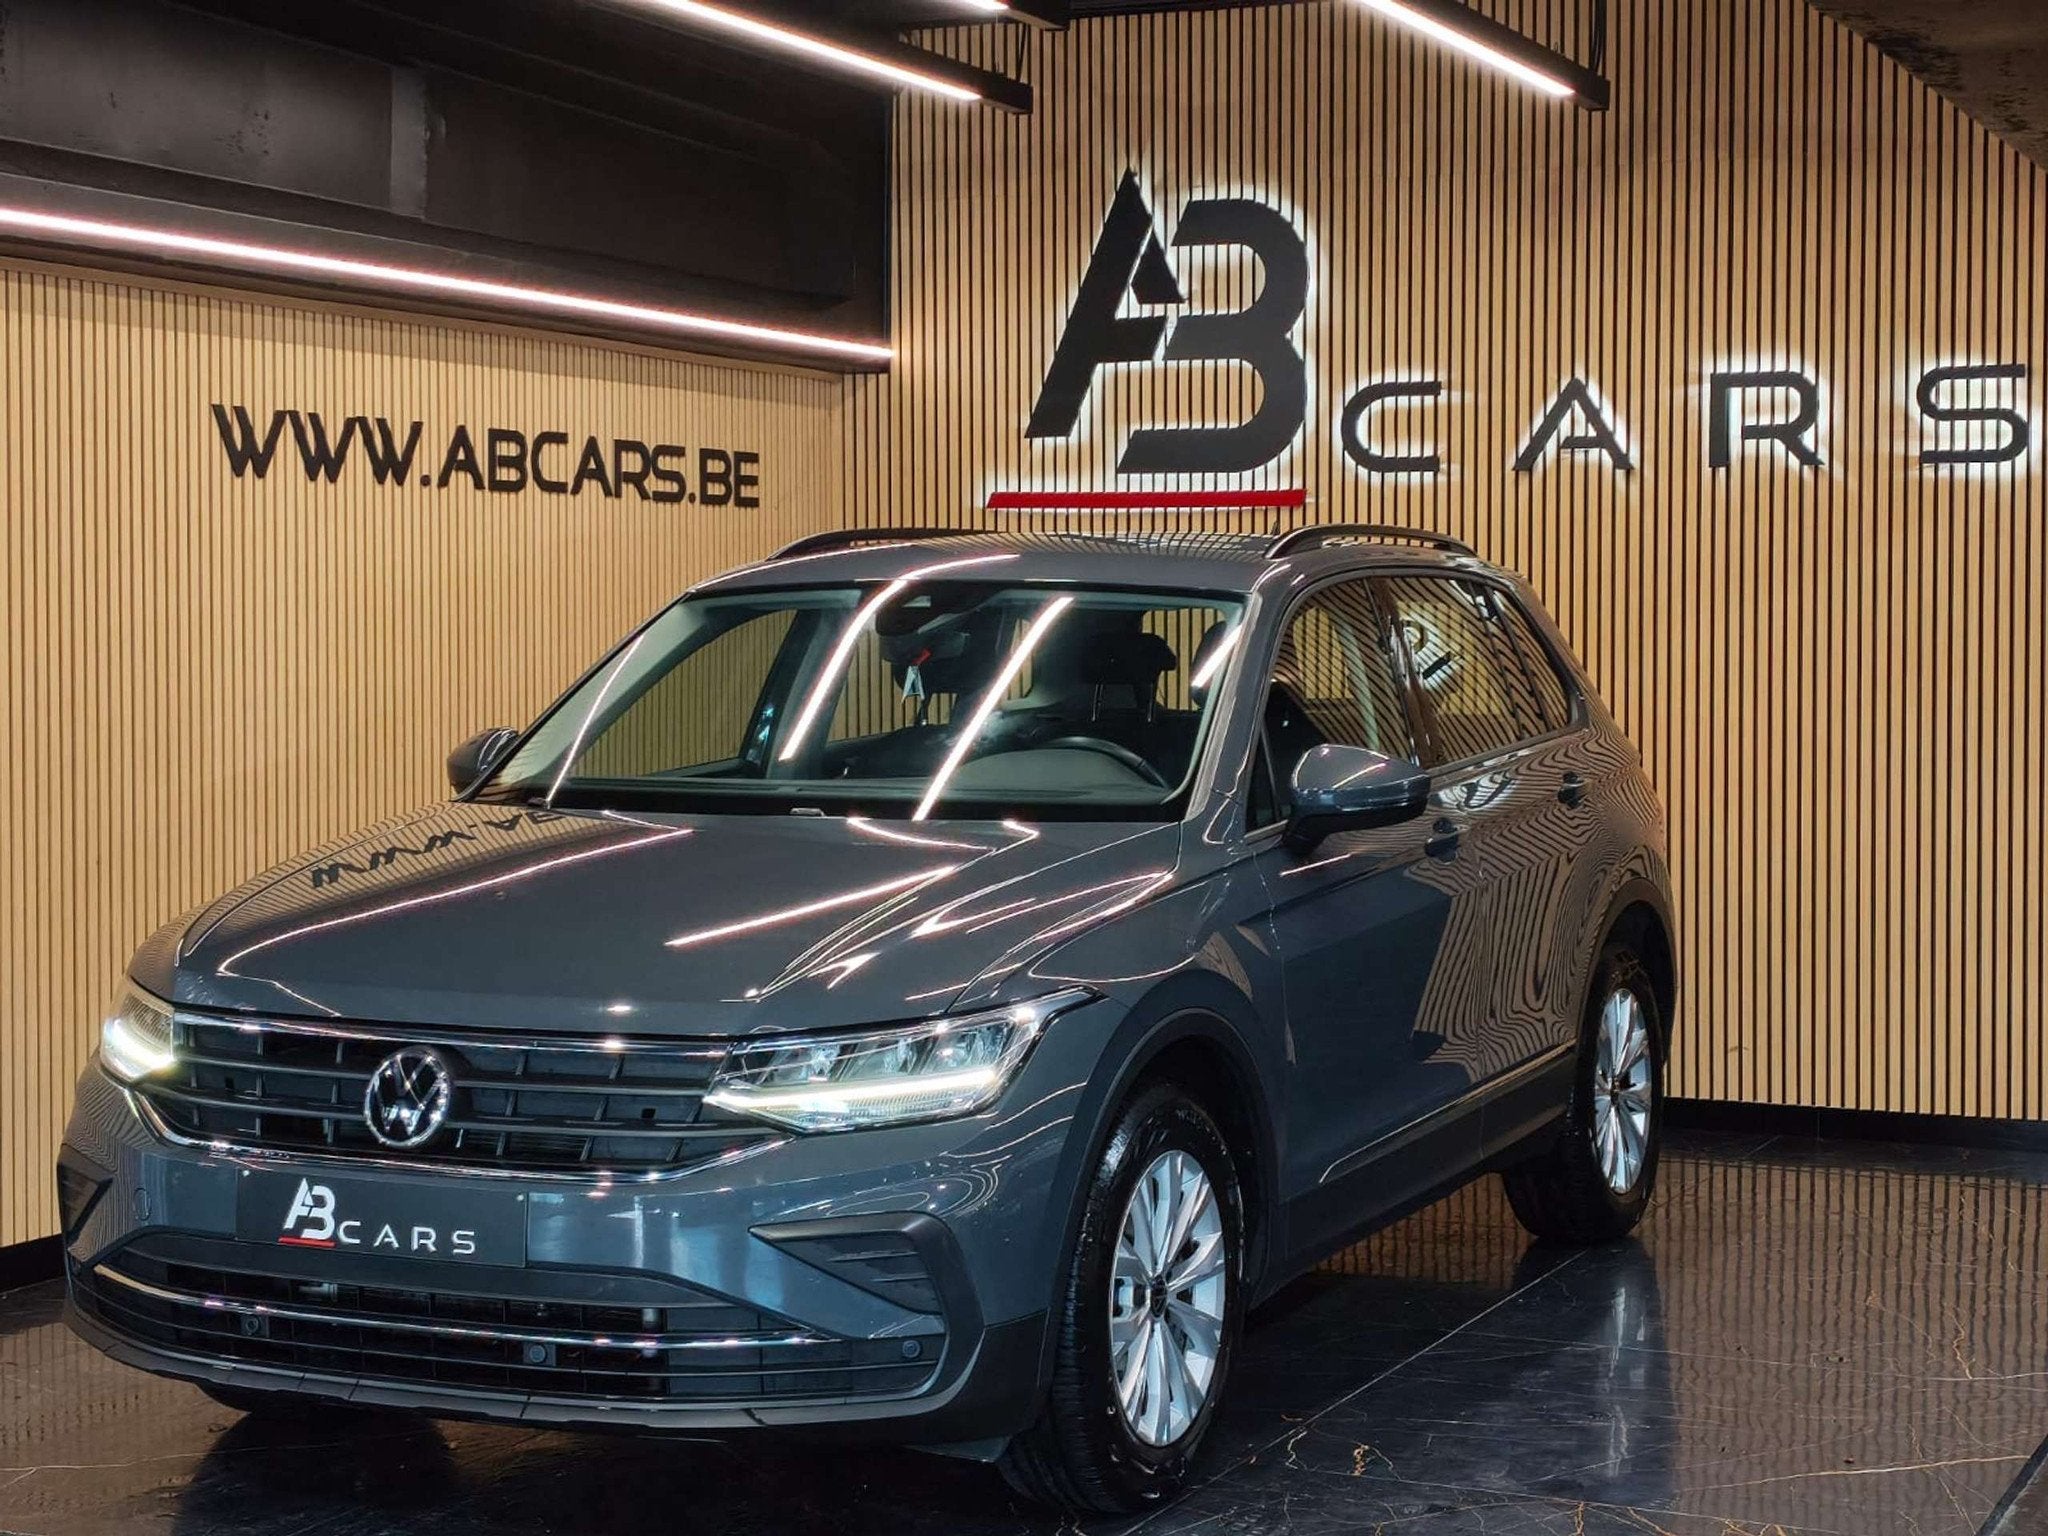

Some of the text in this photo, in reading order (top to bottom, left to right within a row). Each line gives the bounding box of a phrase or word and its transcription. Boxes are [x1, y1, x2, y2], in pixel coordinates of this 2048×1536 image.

[1024, 166, 2030, 475] AB CARS
[211, 404, 759, 508] WWW.ABCARS.BE
[337, 1221, 476, 1255] CARS
